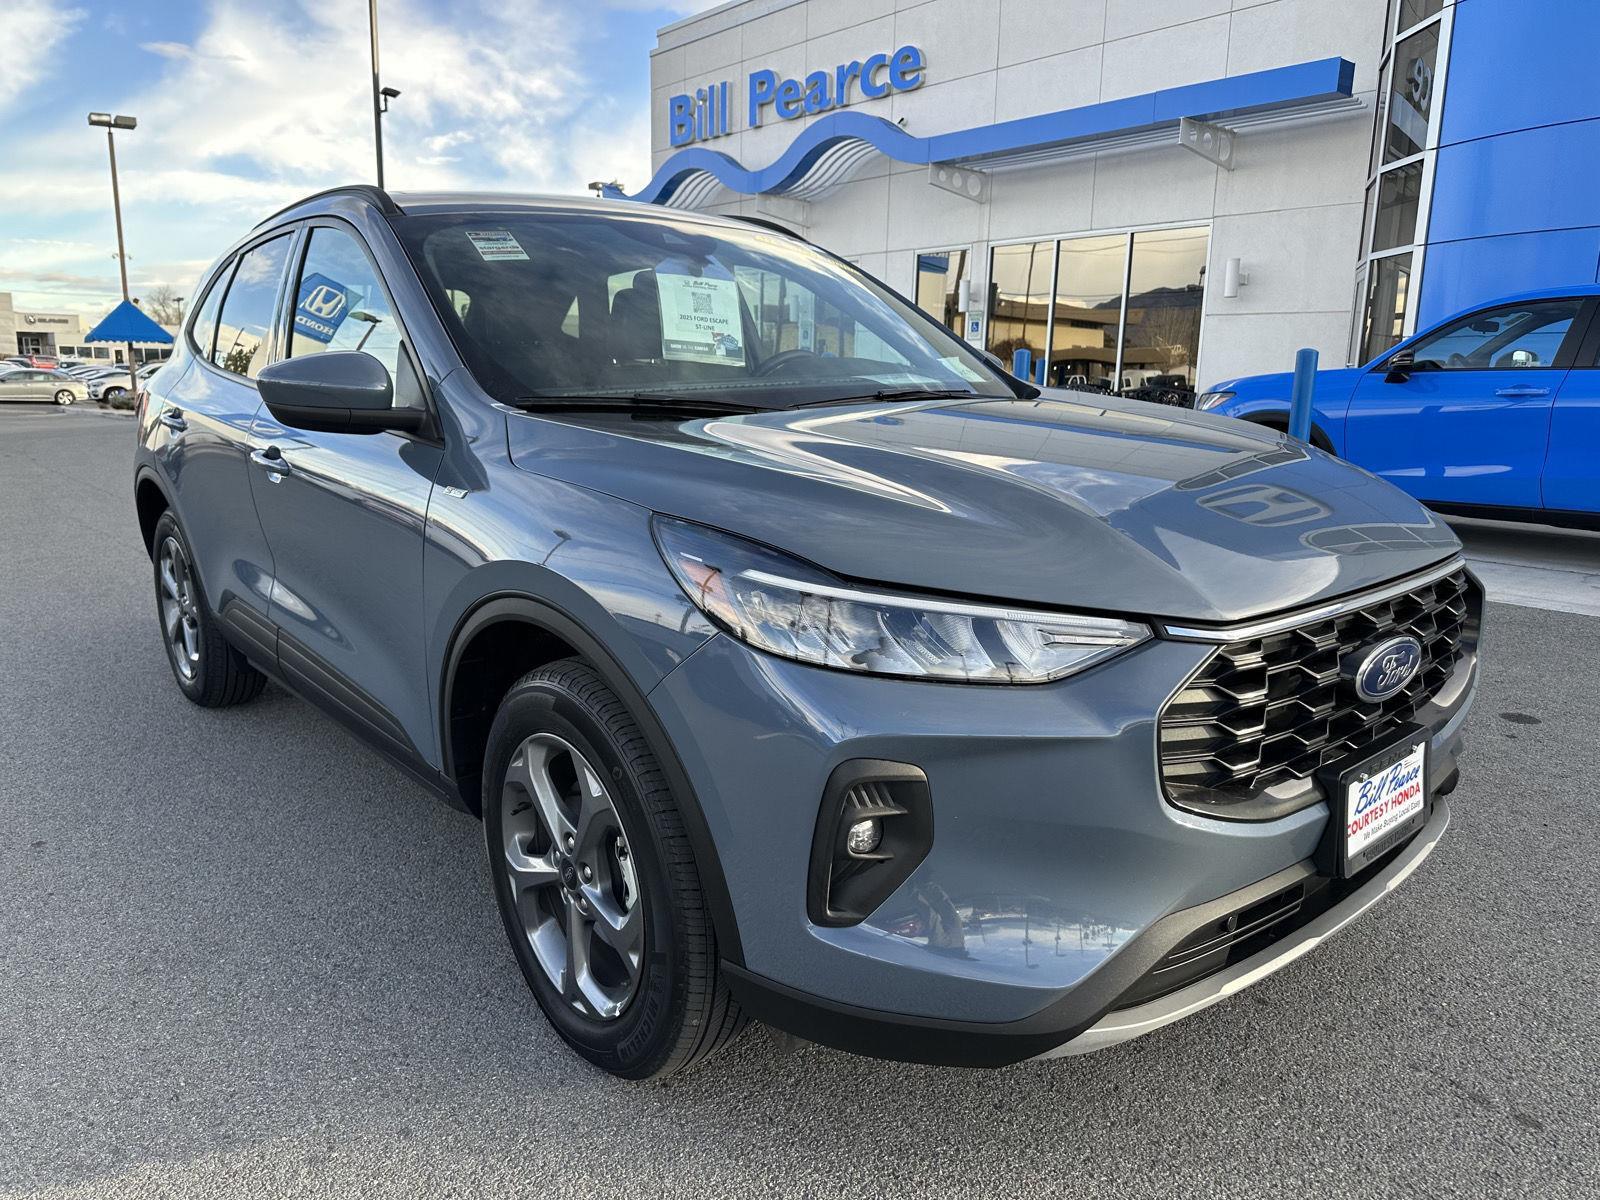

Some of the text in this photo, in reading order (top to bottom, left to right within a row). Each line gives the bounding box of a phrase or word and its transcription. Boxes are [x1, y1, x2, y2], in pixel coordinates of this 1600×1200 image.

[669, 45, 926, 147] Bill Pearce
[694, 315, 708, 323] FORD
[709, 317, 728, 325] ESCAPE
[1377, 651, 1413, 691] Ford
[1346, 799, 1389, 838] COURTESY
[1391, 783, 1420, 809] HONDA
[1354, 763, 1420, 816] Bill Pearce
